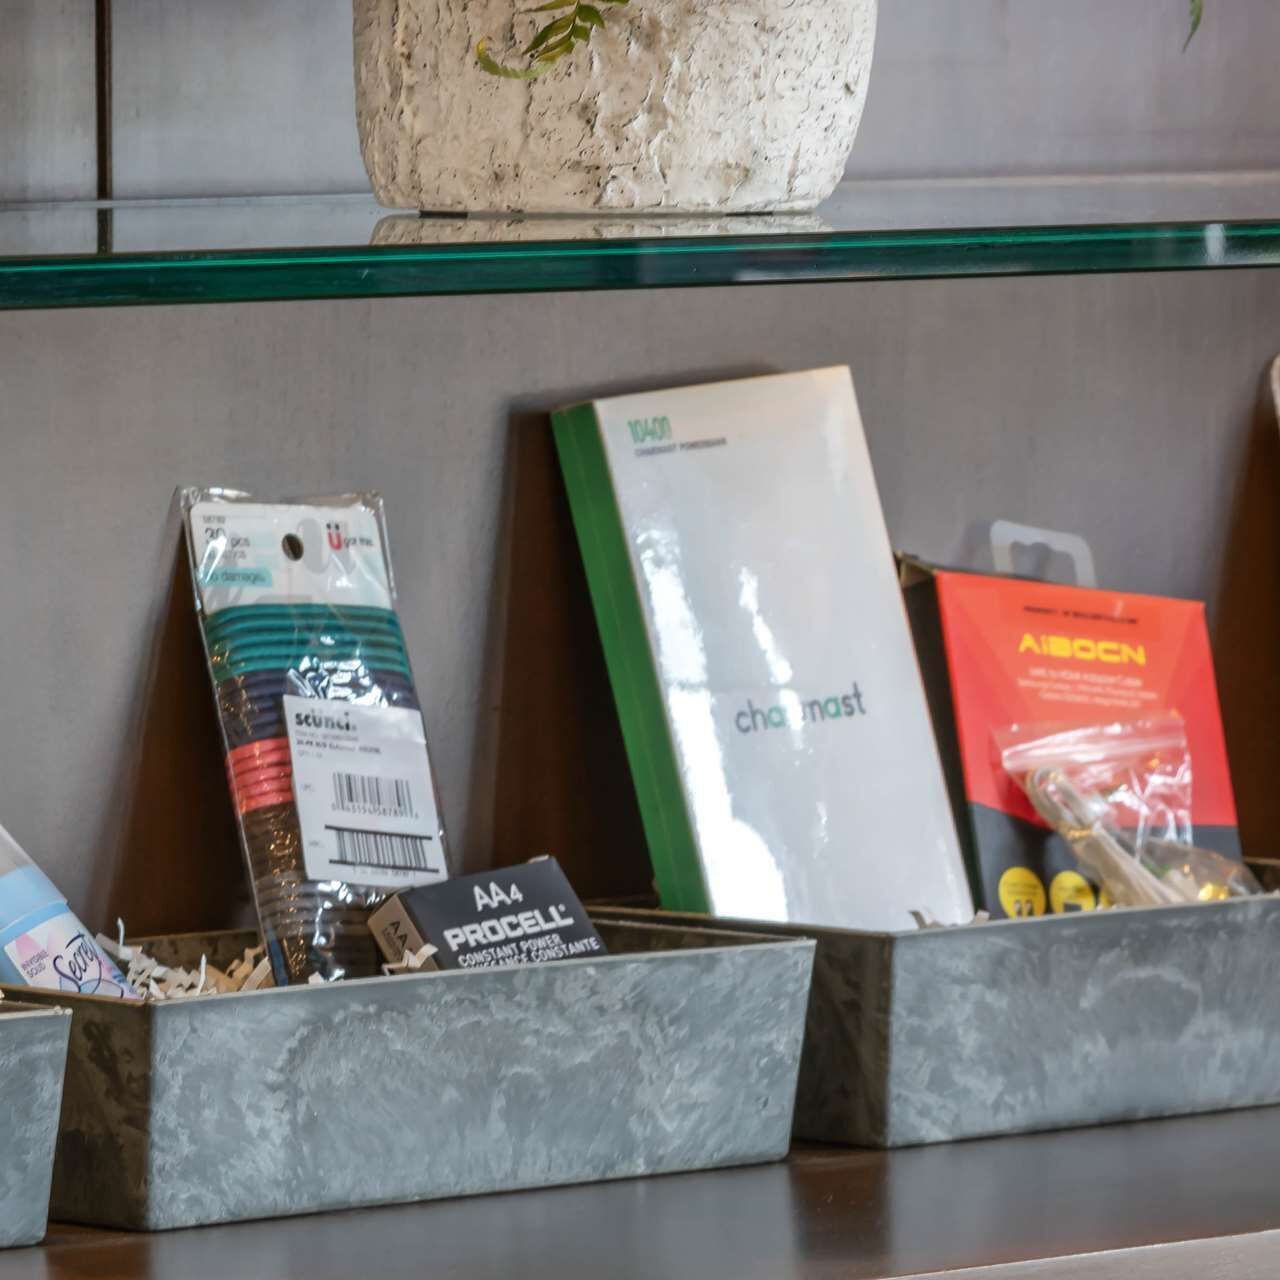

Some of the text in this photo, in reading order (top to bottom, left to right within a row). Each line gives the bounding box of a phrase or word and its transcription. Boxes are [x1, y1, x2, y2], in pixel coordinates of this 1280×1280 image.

[443, 904, 575, 952] PROCELL
[458, 943, 519, 967] CONSTANT
[520, 934, 563, 953] POWER
[531, 936, 600, 963] CONSTANTE
